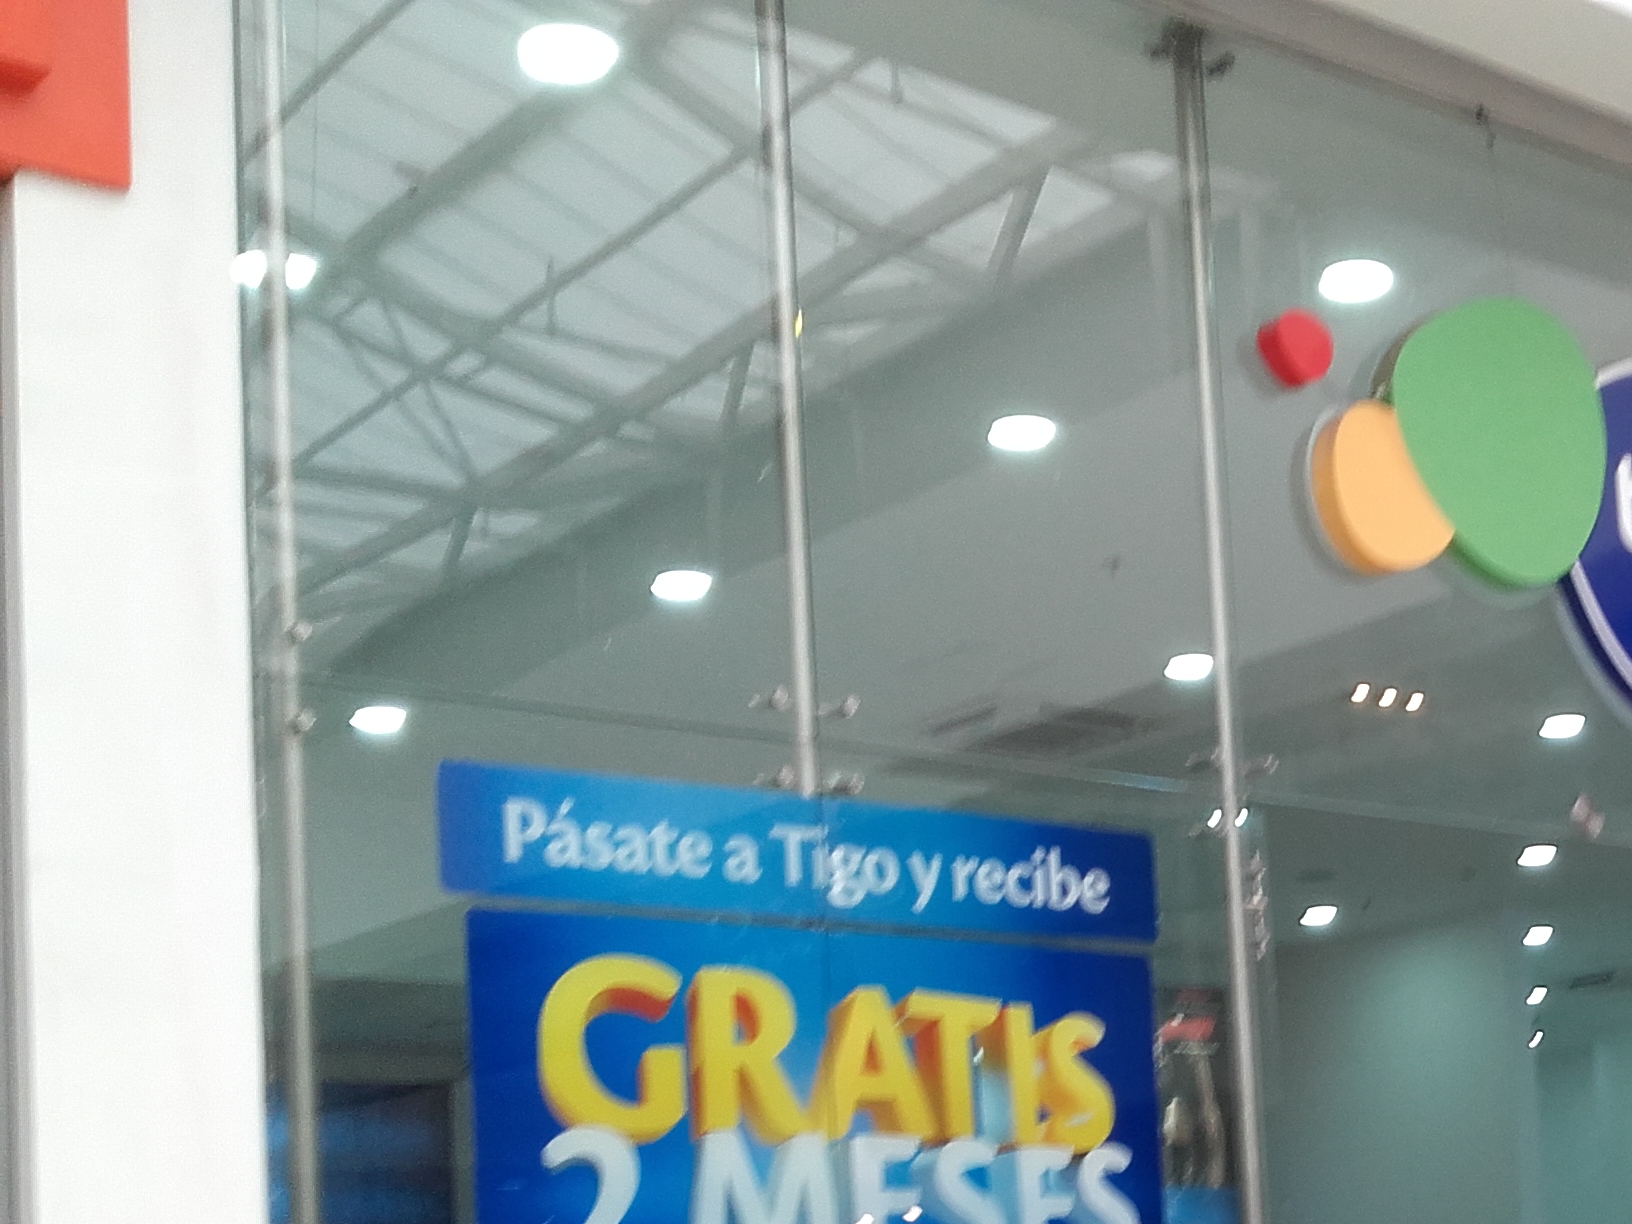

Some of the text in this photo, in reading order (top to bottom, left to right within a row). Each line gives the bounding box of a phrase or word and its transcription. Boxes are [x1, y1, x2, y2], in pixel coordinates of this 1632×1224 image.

[502, 796, 1112, 914] Pásate a Tigo y recibe
[537, 952, 1117, 1155] GRATIS
